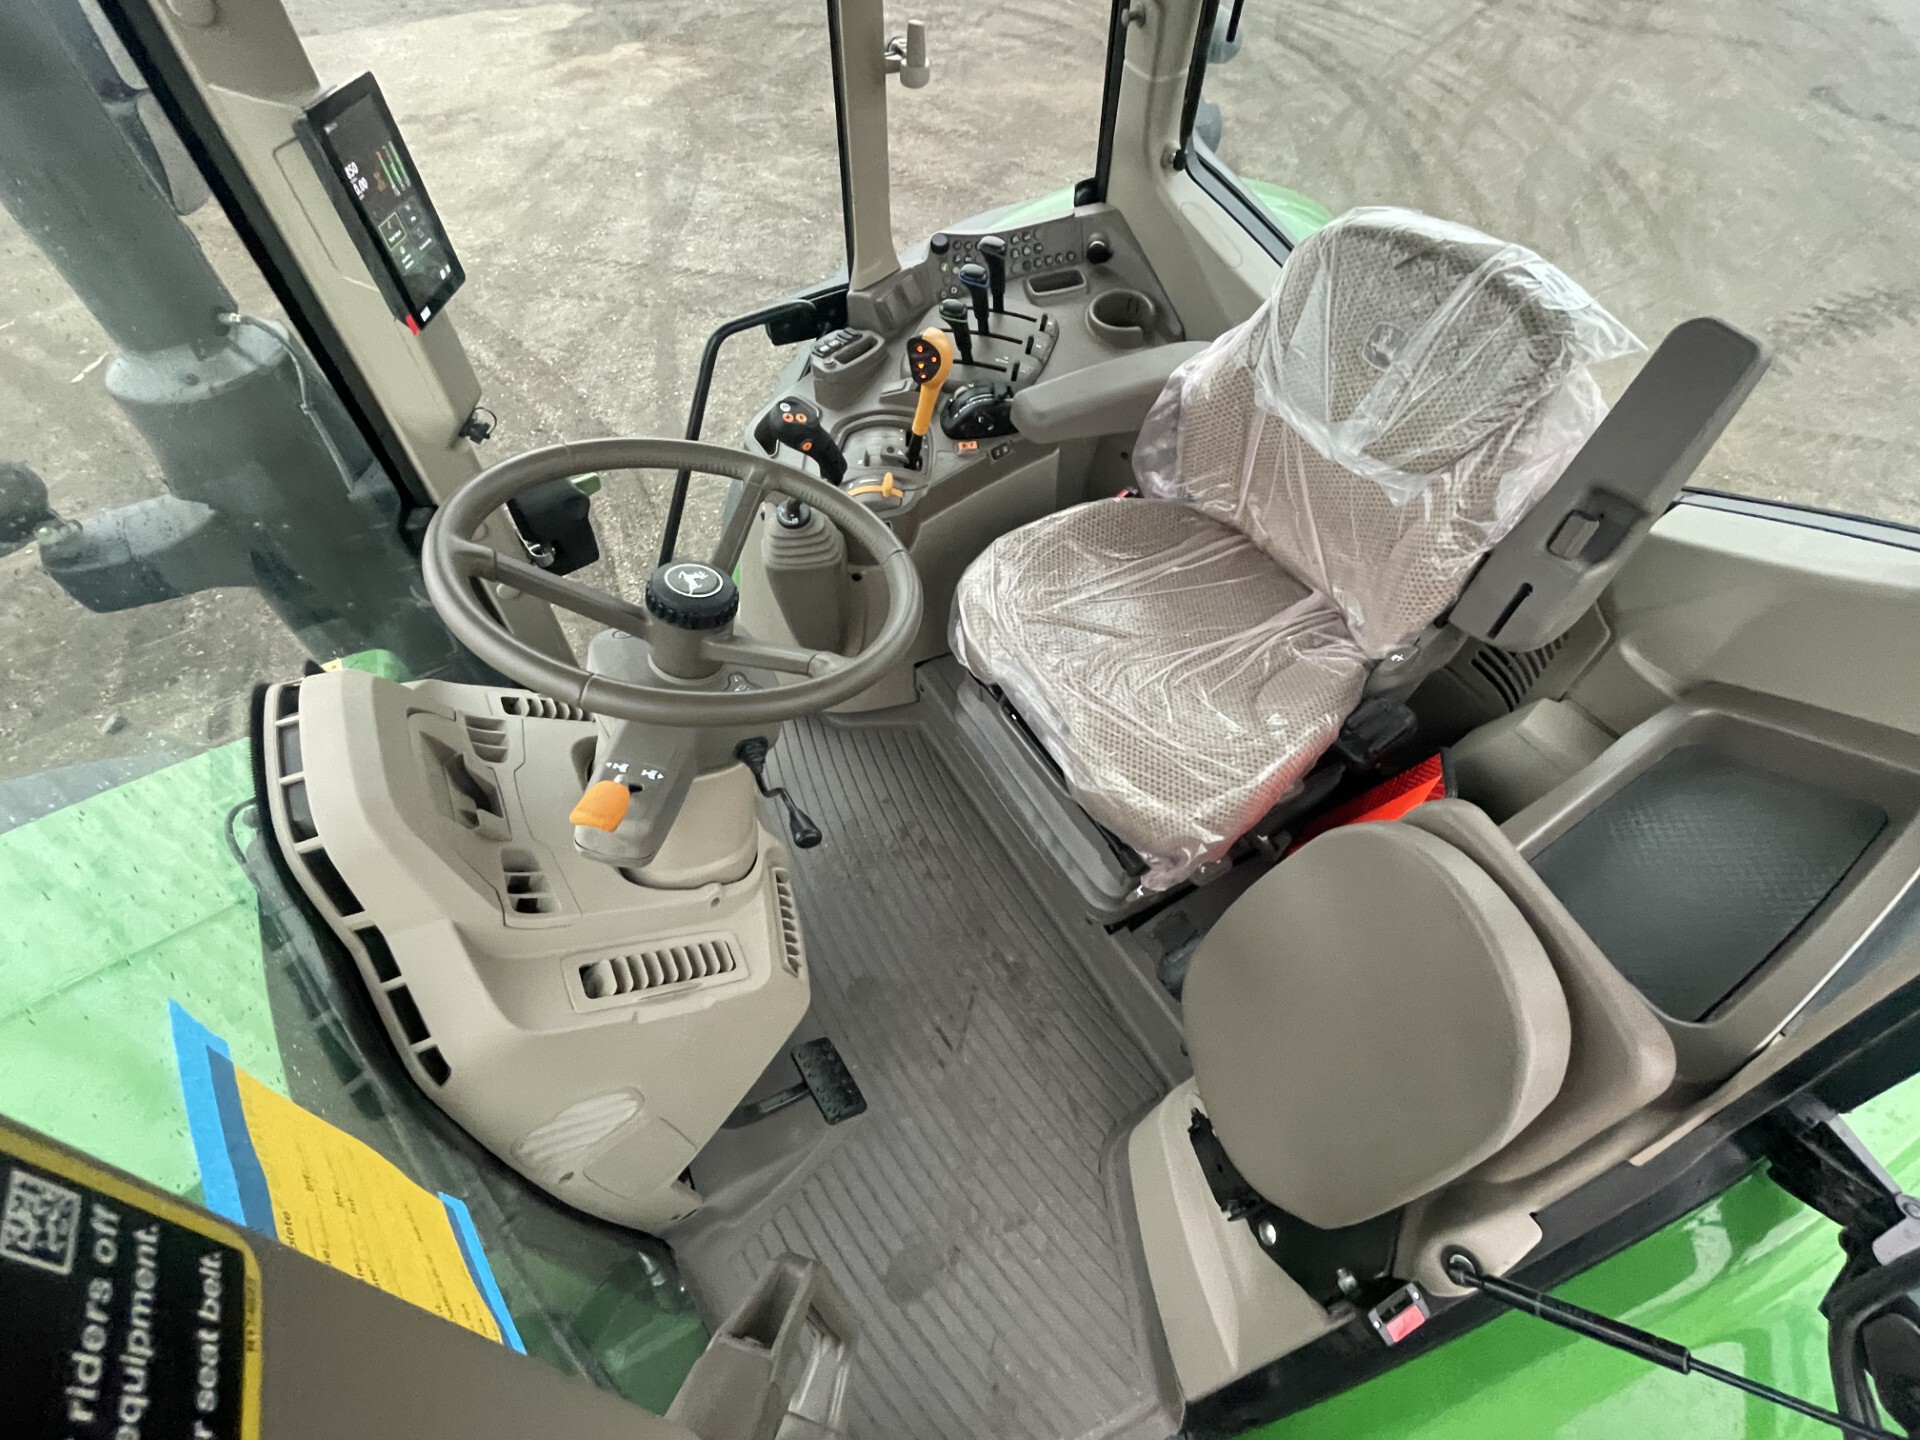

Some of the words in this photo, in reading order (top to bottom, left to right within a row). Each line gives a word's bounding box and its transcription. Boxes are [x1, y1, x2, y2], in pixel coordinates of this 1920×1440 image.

[65, 1277, 114, 1422] riders
[91, 1203, 120, 1264] off
[197, 1252, 223, 1321] belt.
[197, 1328, 220, 1411] seat
